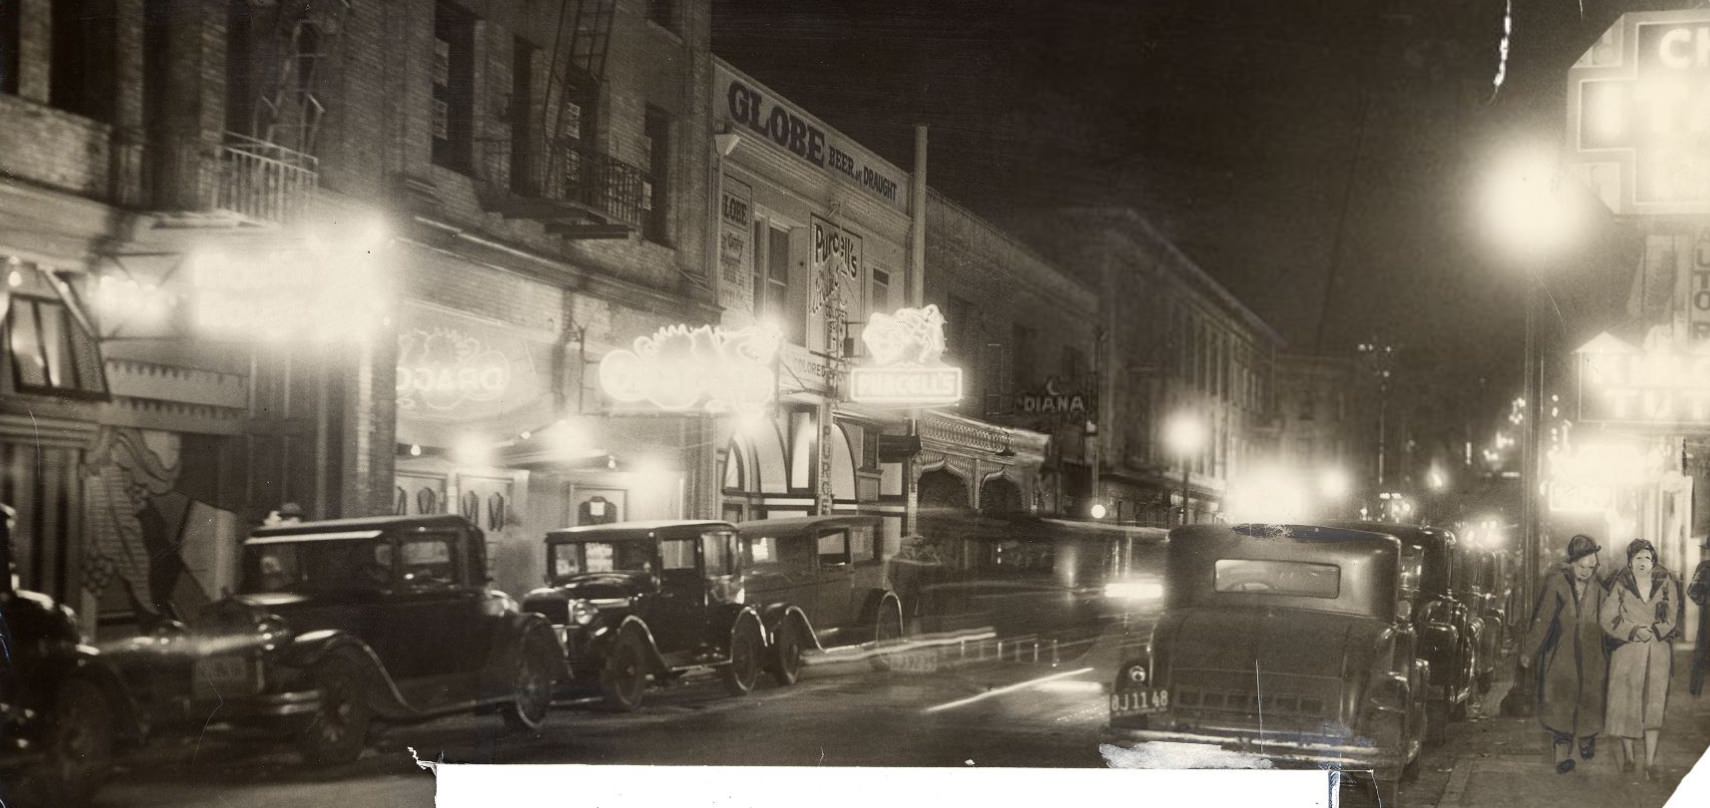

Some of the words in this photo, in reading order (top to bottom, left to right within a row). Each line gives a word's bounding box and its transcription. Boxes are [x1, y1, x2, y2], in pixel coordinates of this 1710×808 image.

[728, 80, 824, 169] GLOBE
[829, 146, 854, 177] BEER
[864, 166, 897, 201] DRAUGHT
[1024, 396, 1085, 411] DIANA
